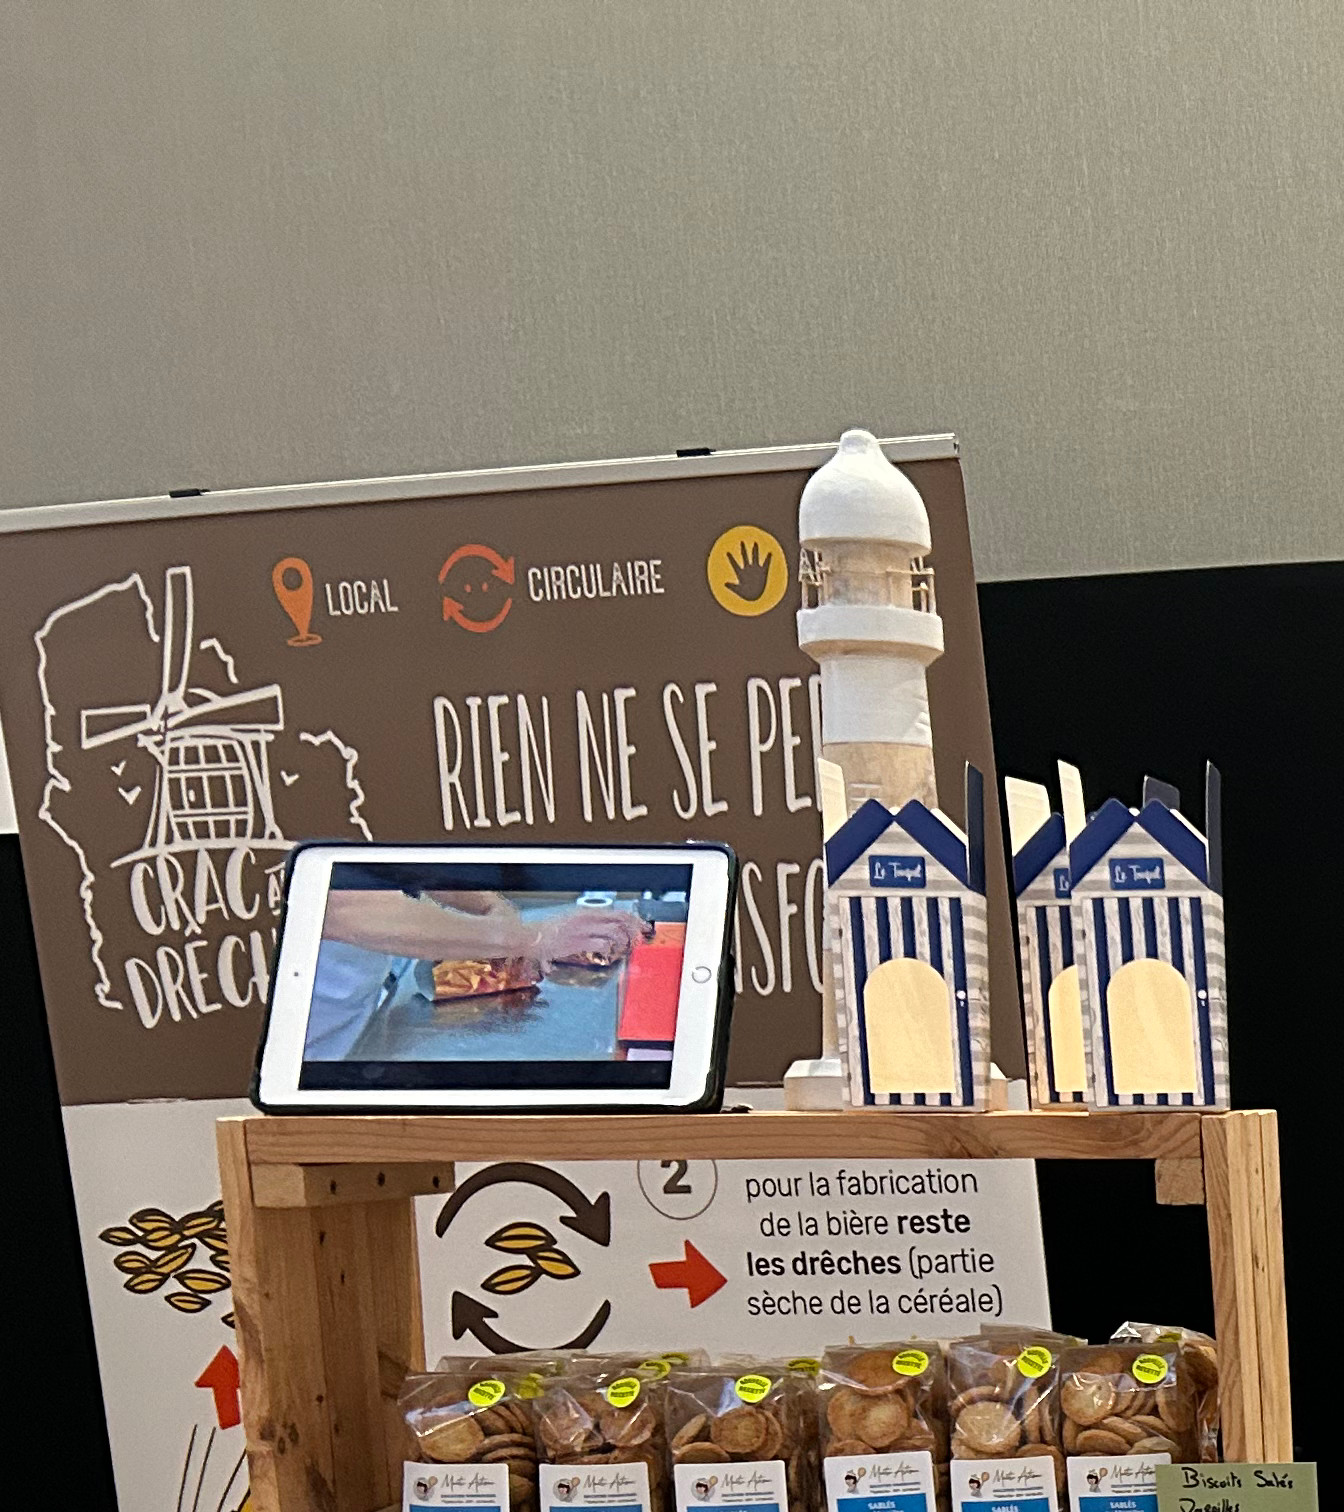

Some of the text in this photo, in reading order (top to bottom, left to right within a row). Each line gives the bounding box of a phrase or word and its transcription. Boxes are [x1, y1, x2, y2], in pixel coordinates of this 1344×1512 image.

[325, 558, 667, 618] LOCAL CIRCULAIRE
[432, 691, 558, 833] RIEN
[575, 685, 649, 827] NE
[662, 678, 731, 819] SE
[127, 847, 259, 937] CRAC
[659, 1159, 693, 1195] 2
[744, 1168, 980, 1201] pour la fabrication
[759, 1208, 973, 1238] de la bière reste
[746, 1247, 996, 1278] les drêches (partie
[746, 1285, 1005, 1320] sèche de la céréale)
